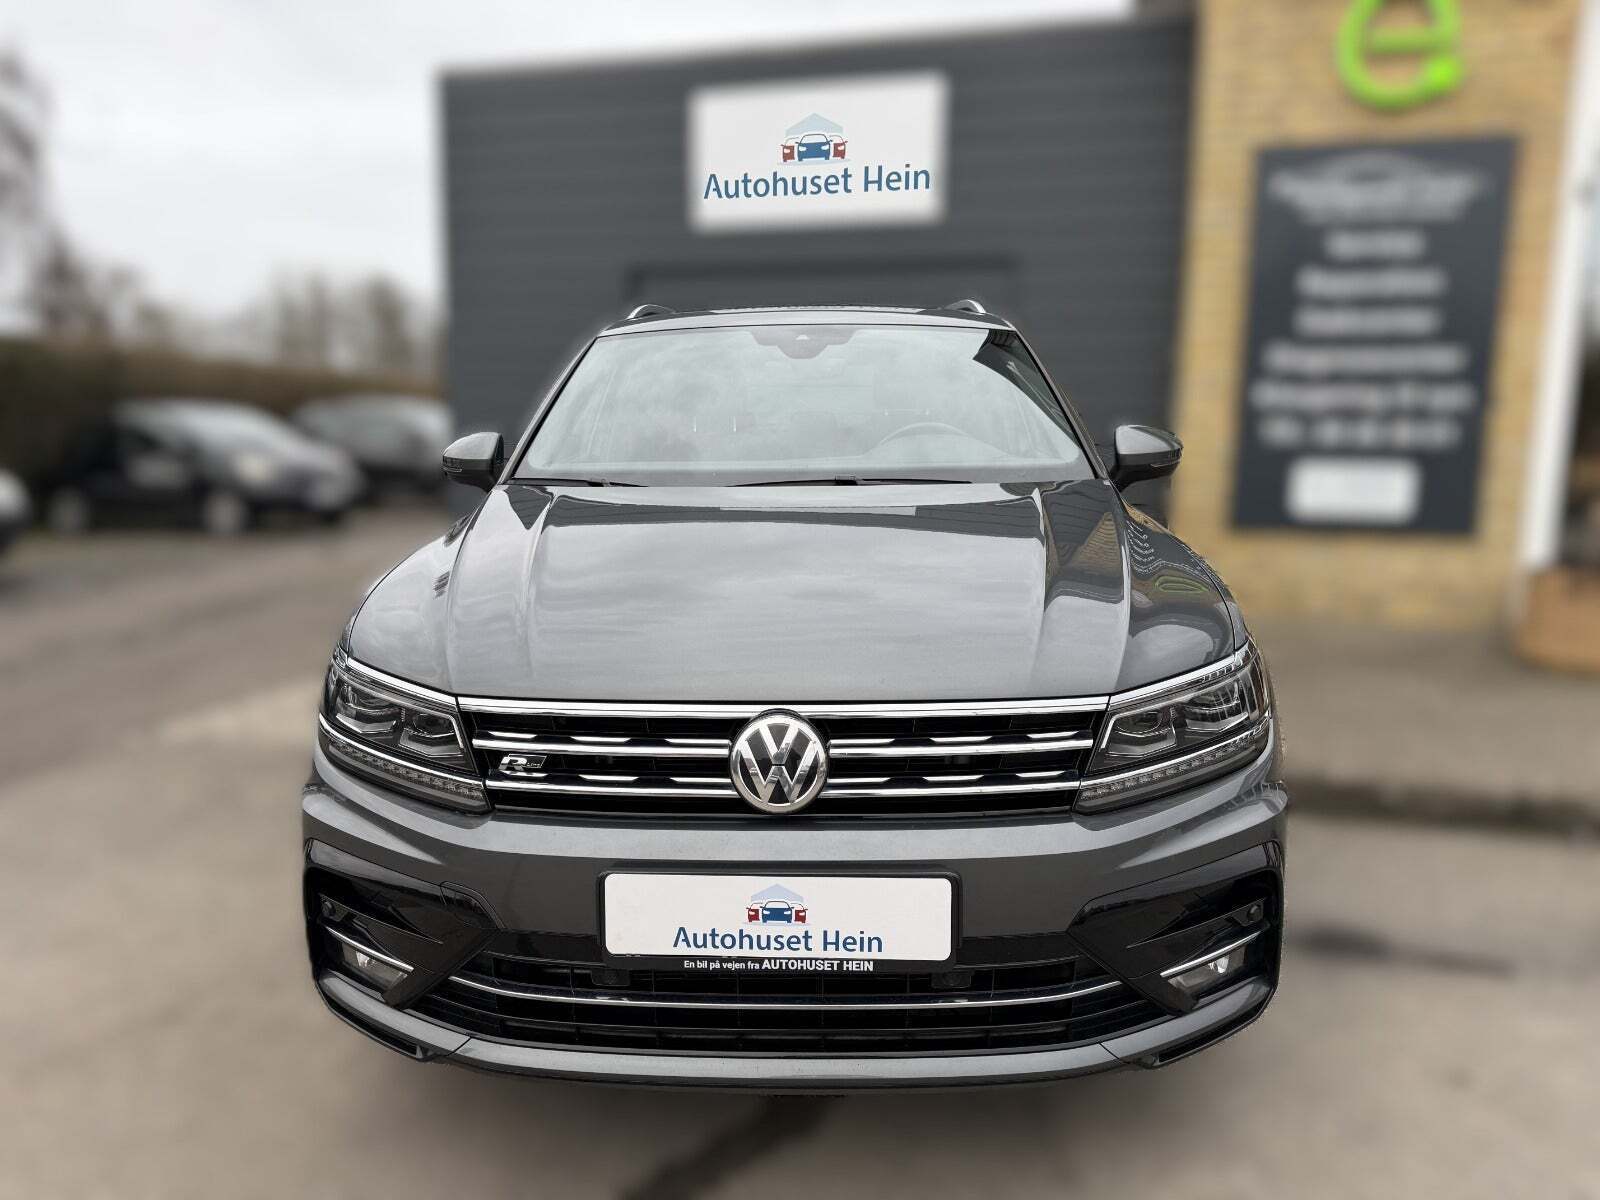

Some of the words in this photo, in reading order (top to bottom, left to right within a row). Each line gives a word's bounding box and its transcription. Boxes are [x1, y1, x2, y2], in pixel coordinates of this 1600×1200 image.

[703, 167, 853, 200] Autohuset
[863, 163, 931, 193] Hein
[673, 926, 813, 951] Autohuset
[822, 929, 883, 953] Hein
[684, 960, 695, 969] En
[696, 960, 708, 969] bil
[709, 960, 721, 971] på
[722, 961, 746, 971] vejen
[747, 961, 760, 970] fra
[761, 959, 841, 971] AUTOHUSET
[843, 960, 875, 972] HEIN
